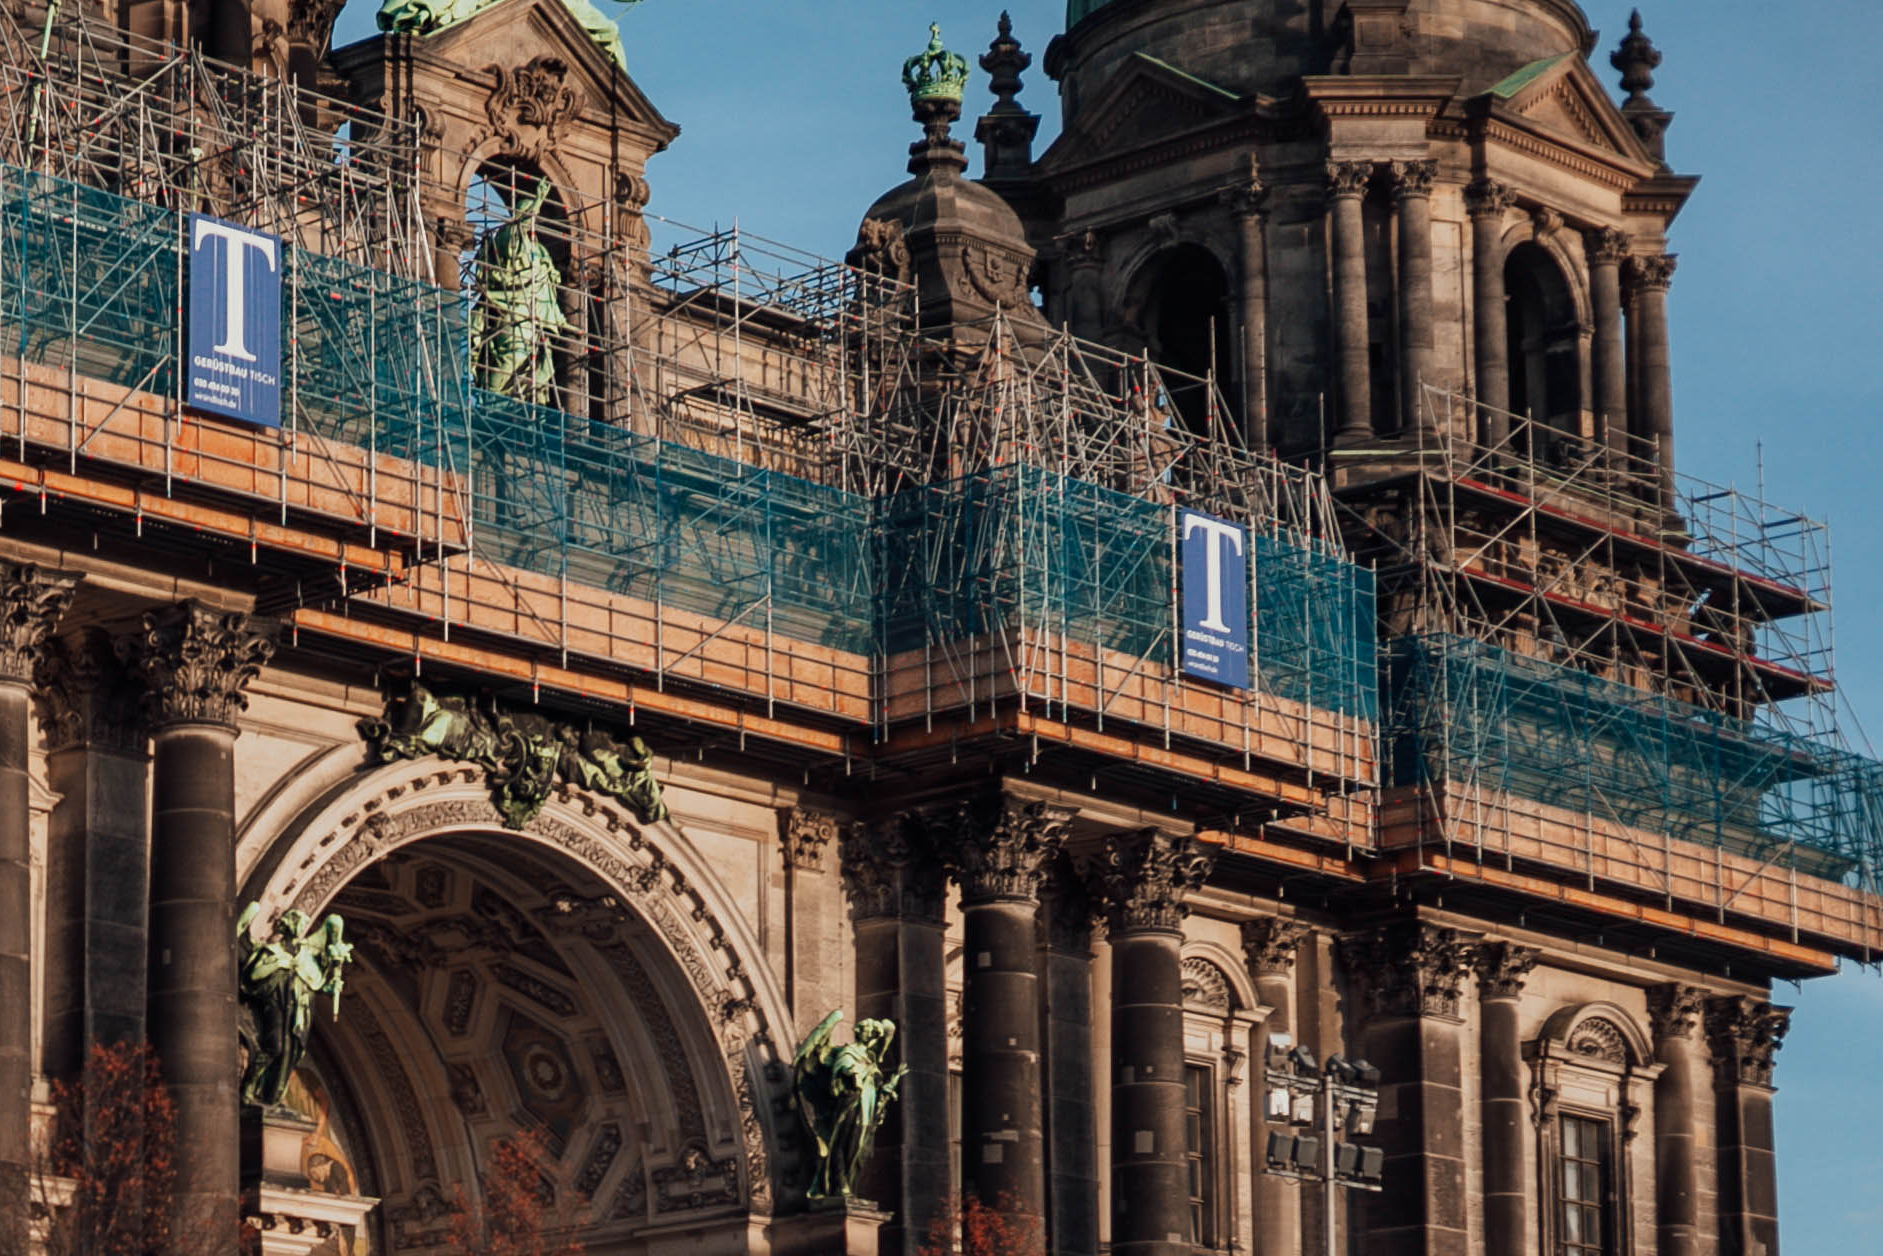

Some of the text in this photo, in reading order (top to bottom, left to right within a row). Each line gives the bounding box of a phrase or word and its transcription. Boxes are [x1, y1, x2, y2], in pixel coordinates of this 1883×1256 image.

[194, 219, 276, 362] T
[194, 355, 276, 387] GERÜSTBAU TISCH
[1184, 513, 1243, 634] T
